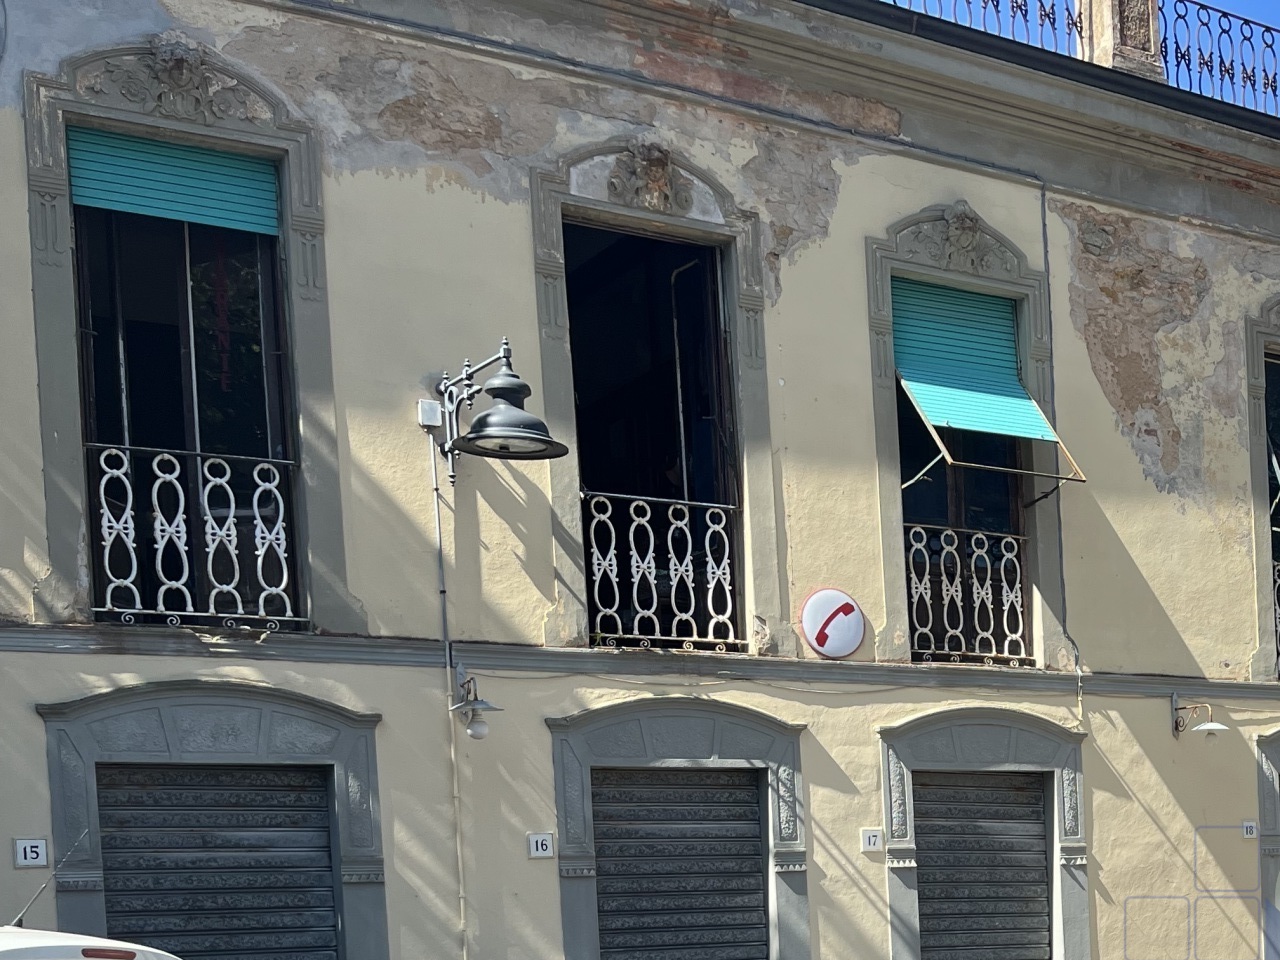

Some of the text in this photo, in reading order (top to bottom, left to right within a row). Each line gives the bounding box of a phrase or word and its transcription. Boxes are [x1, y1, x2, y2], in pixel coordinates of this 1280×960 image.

[1245, 825, 1254, 836] 18
[535, 838, 549, 852] 16
[867, 834, 878, 847] 17
[23, 844, 40, 860] 15
